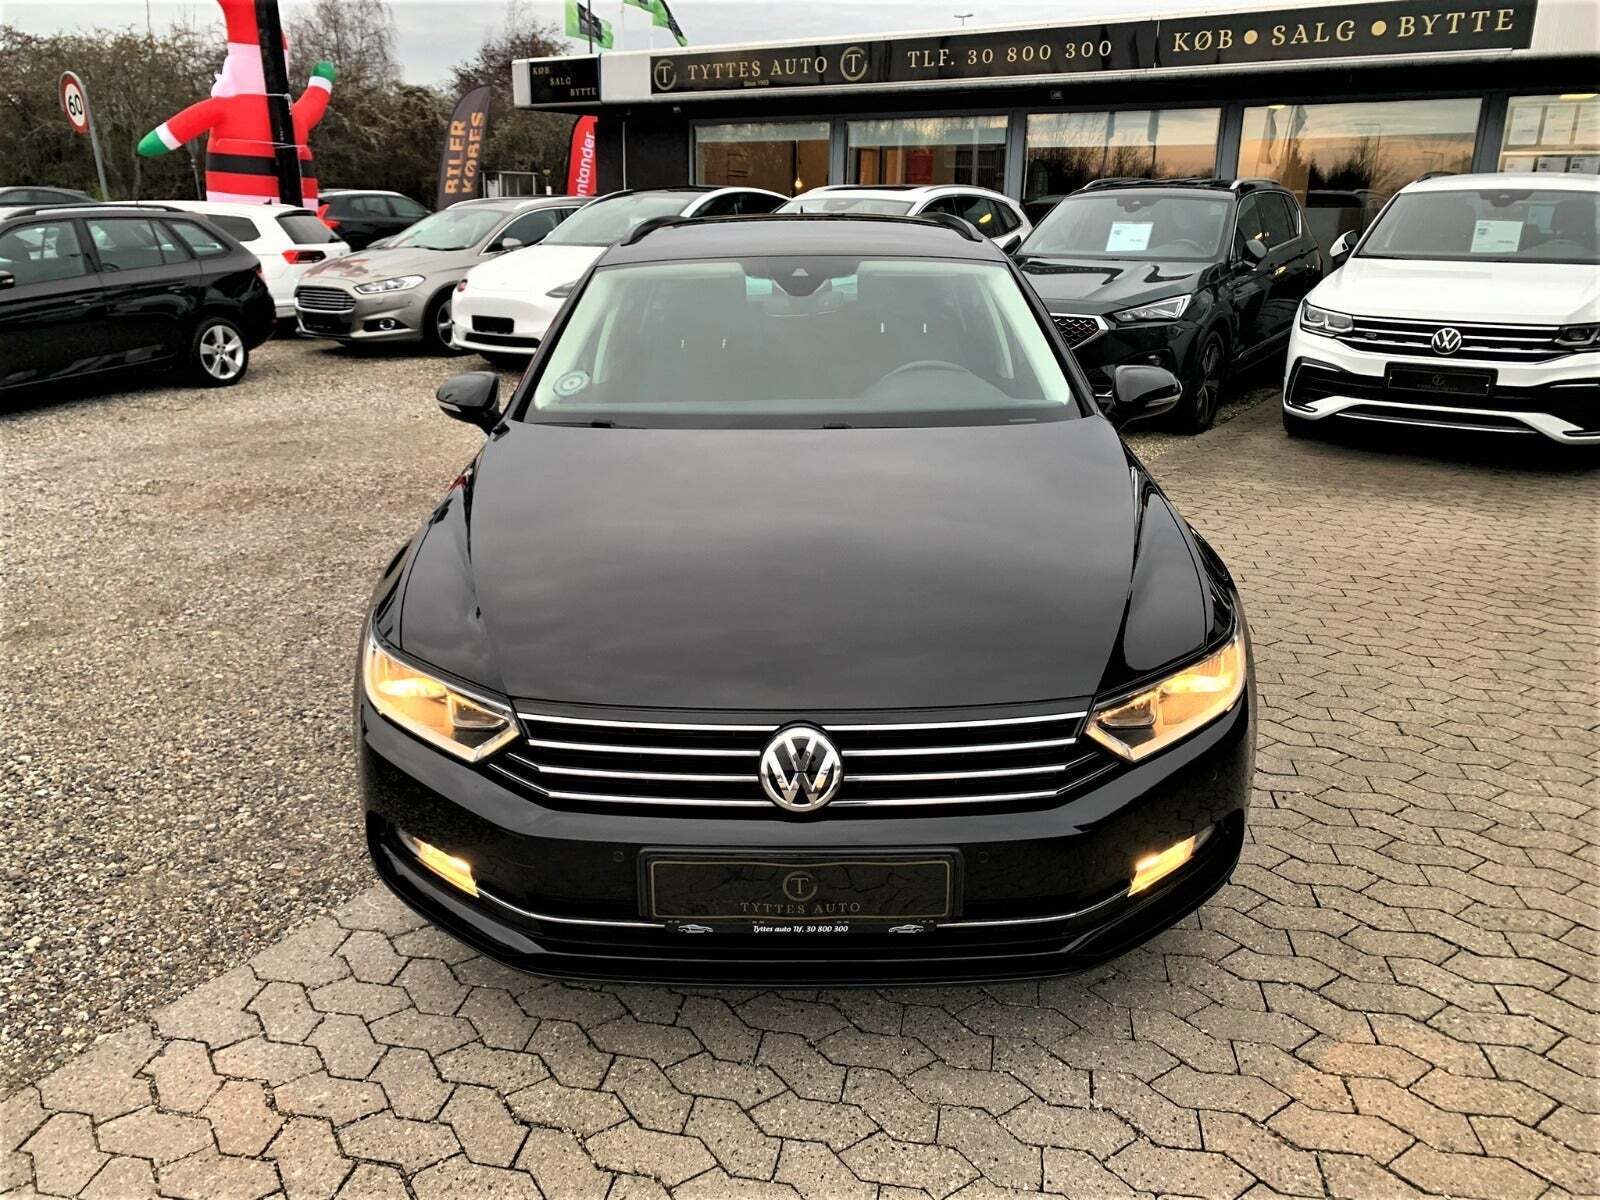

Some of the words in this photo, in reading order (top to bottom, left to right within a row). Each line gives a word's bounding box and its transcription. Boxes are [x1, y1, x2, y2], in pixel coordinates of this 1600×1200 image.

[1173, 28, 1234, 52] KØB
[1271, 20, 1356, 46] SALG
[1397, 9, 1515, 38] BYTTE
[687, 60, 761, 80] TYTTES
[770, 56, 828, 76] AUTO
[907, 48, 955, 68] TLF.
[967, 48, 994, 65] 30
[1006, 45, 1052, 63] 800
[1065, 40, 1113, 59] 300
[68, 94, 83, 116] 60
[570, 88, 597, 97] BYTTE
[444, 120, 467, 194] BILER
[462, 111, 485, 194] KØBES
[575, 131, 596, 198] ntander
[761, 728, 841, 810] VW
[740, 902, 806, 915] TYTTES
[815, 902, 861, 914] AUTO
[753, 925, 773, 933] Tyttes
[806, 925, 817, 933] 30
[817, 925, 832, 933] 800
[833, 925, 849, 933] 300
